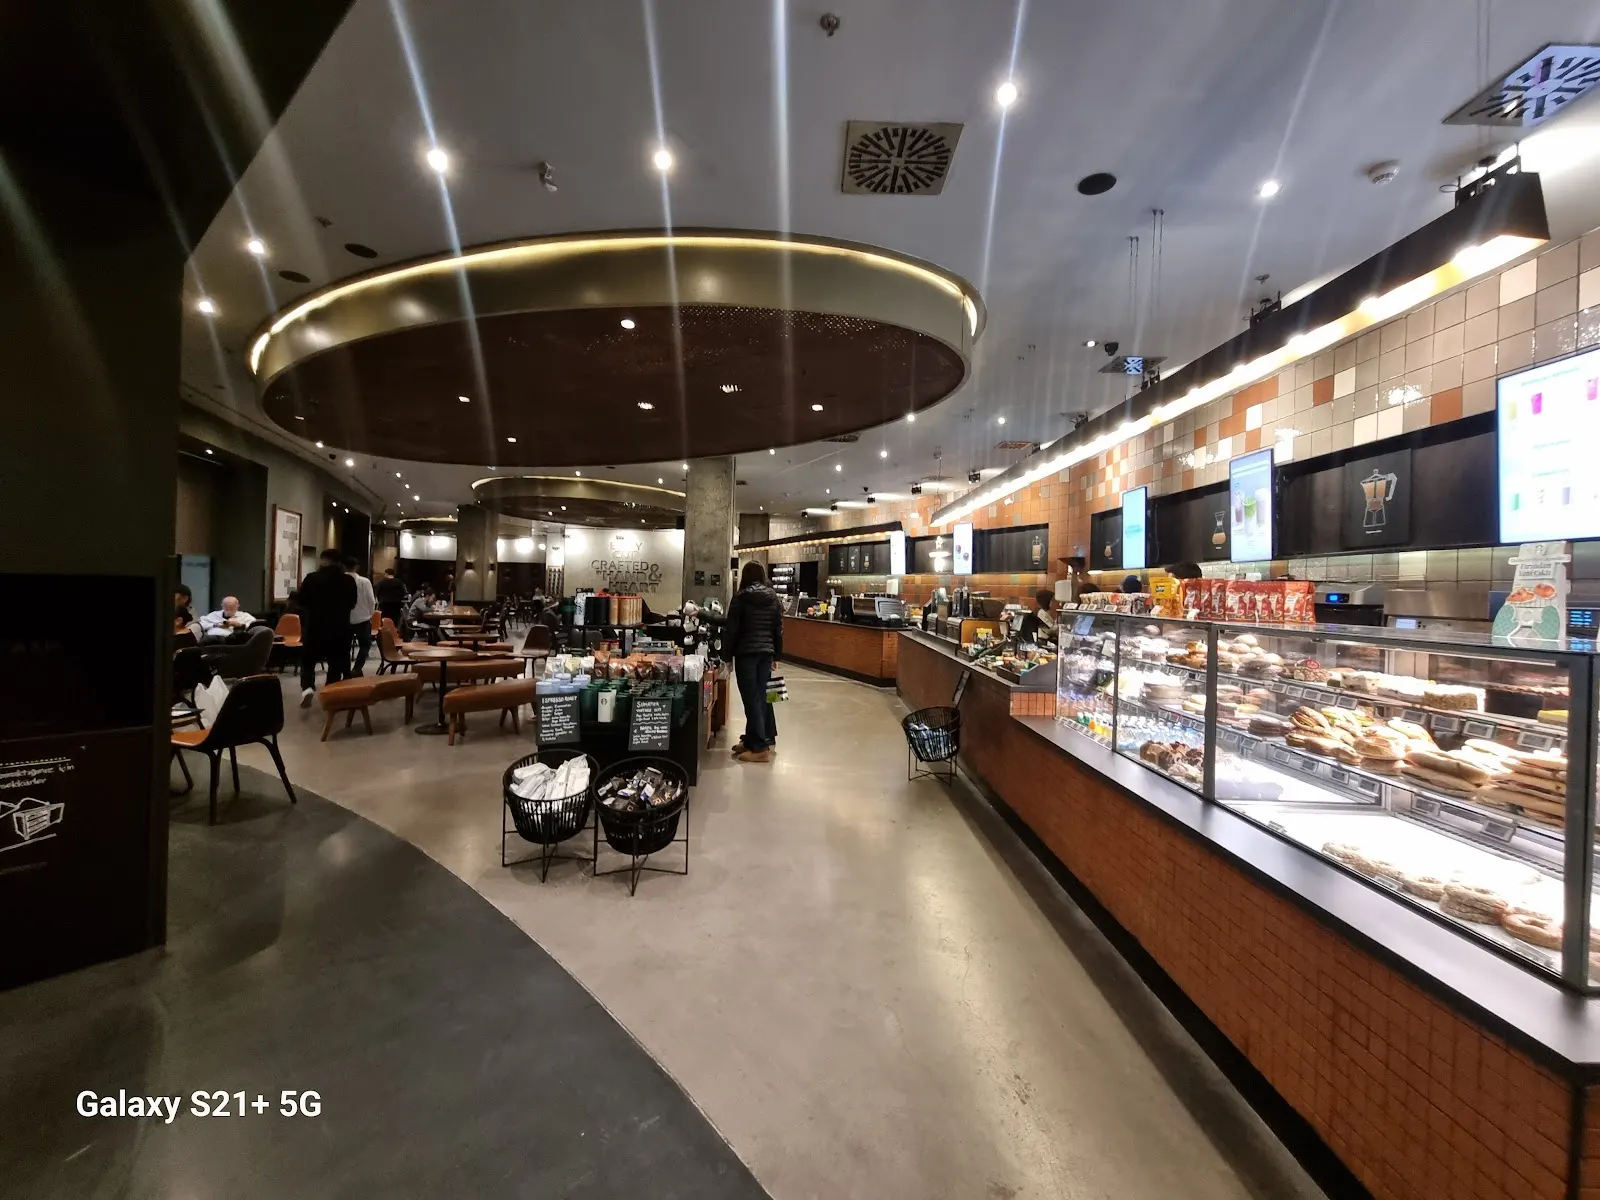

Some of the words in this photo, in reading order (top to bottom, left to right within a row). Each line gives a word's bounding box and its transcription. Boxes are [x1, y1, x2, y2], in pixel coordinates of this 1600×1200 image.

[591, 559, 649, 571] CRAFTED
[602, 570, 647, 581] HAND
[648, 563, 662, 582] &
[608, 581, 659, 593] HEART
